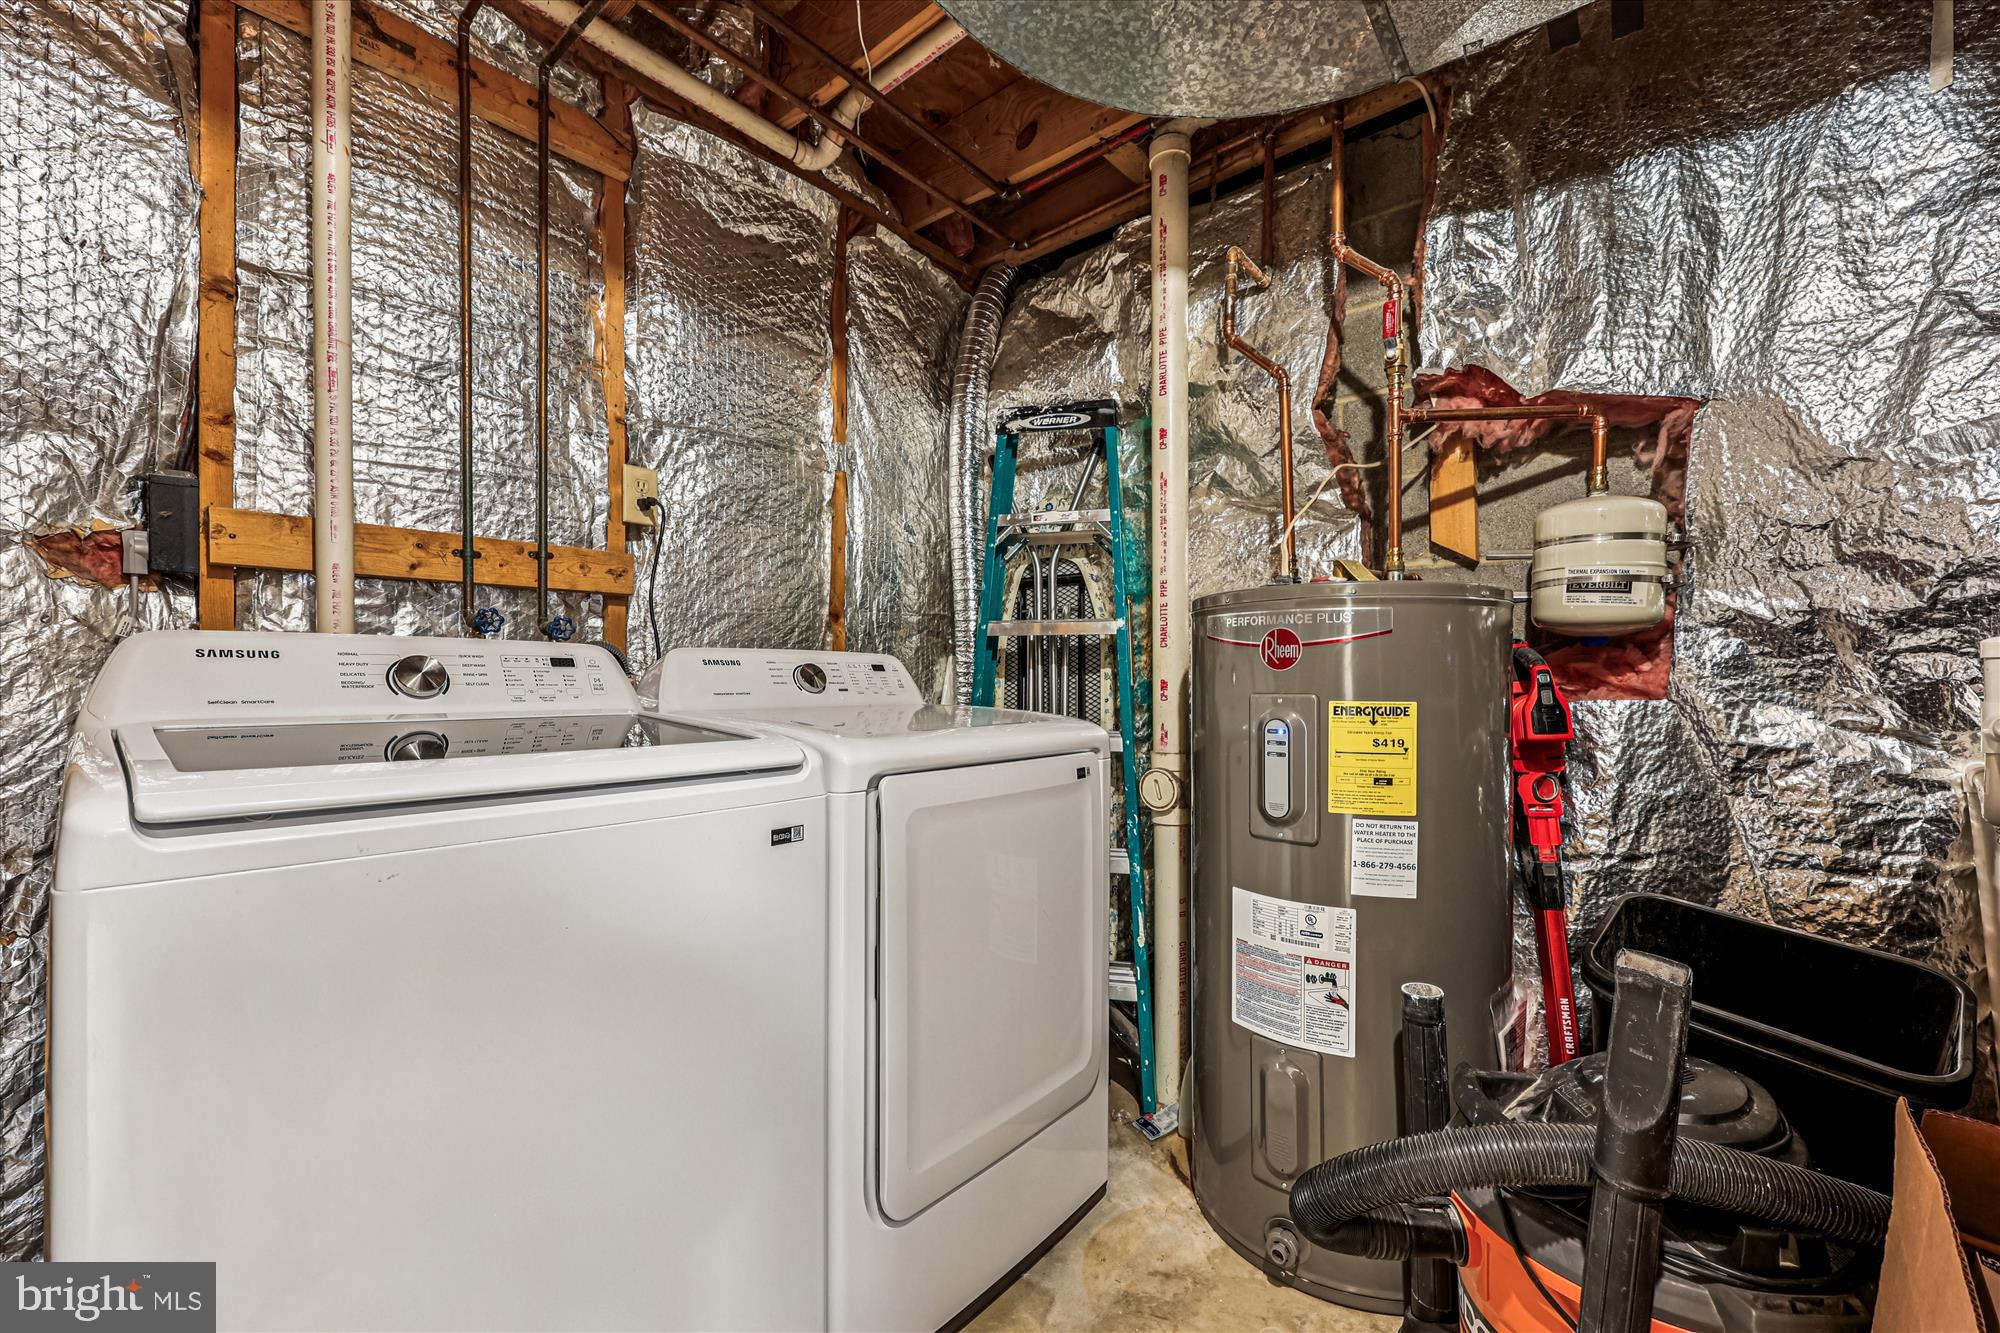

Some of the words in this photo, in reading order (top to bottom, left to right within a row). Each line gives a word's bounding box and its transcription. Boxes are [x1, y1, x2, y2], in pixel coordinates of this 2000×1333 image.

[1159, 326, 1167, 346] PIPE
[1159, 348, 1167, 396] CHARLOTTE
[1032, 416, 1077, 426] WERNER
[1160, 579, 1168, 597] PIPE
[1572, 581, 1626, 589] EVERBILT
[1160, 602, 1168, 648] CHARLOTTE
[1226, 614, 1313, 627] PERFORMANCE
[1316, 612, 1352, 624] PLUS
[195, 649, 280, 659] SAMSUNG
[1264, 629, 1299, 664] Rheem
[1333, 705, 1410, 717] ENERGYGUIDE
[1372, 738, 1405, 748] $419
[1353, 860, 1416, 870] 1-866-279-4566
[1179, 941, 1187, 986] CHARLOTTE
[1314, 959, 1347, 969] DANGER
[1560, 997, 1575, 1055] CRAFTSMAN
